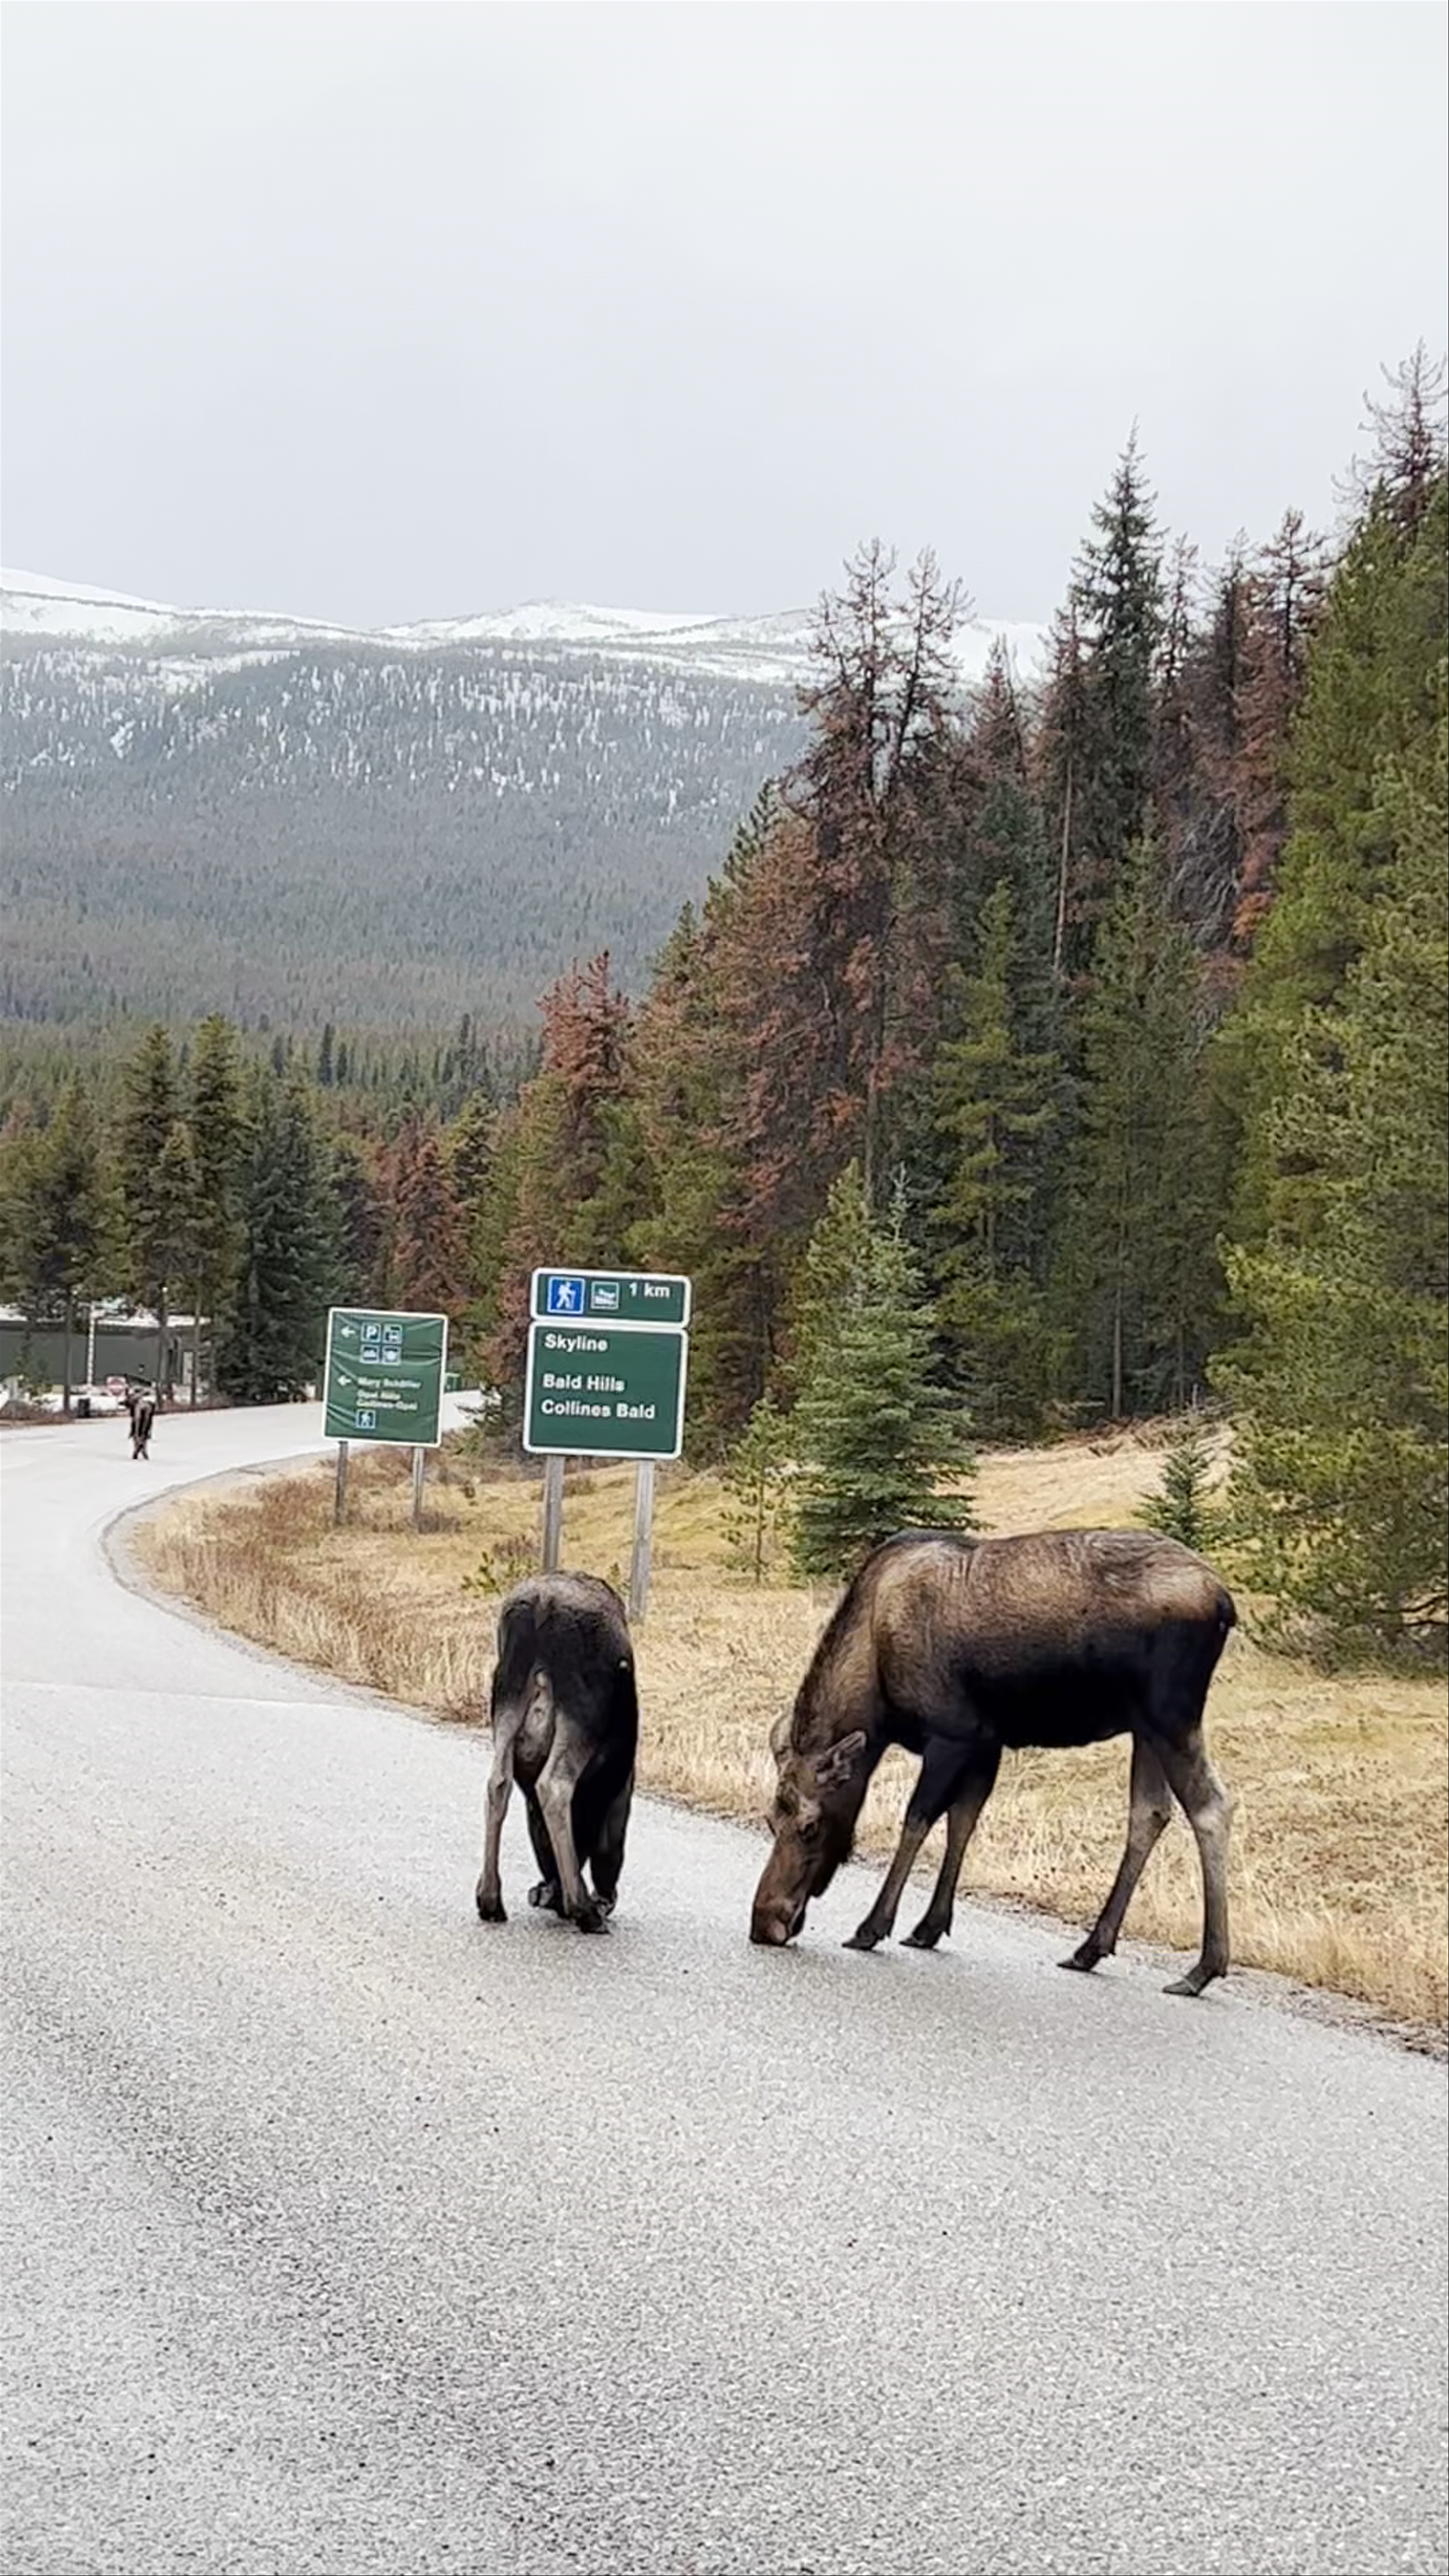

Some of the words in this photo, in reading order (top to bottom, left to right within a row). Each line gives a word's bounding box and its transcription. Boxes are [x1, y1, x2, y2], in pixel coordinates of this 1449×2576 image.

[629, 1283, 637, 1296] 1
[644, 1283, 670, 1297] km
[366, 1326, 377, 1339] P
[545, 1333, 608, 1352] Skyline
[543, 1373, 582, 1389] Bald
[587, 1376, 625, 1392] Hills
[541, 1399, 611, 1417] Collines
[617, 1403, 655, 1419] Bald
